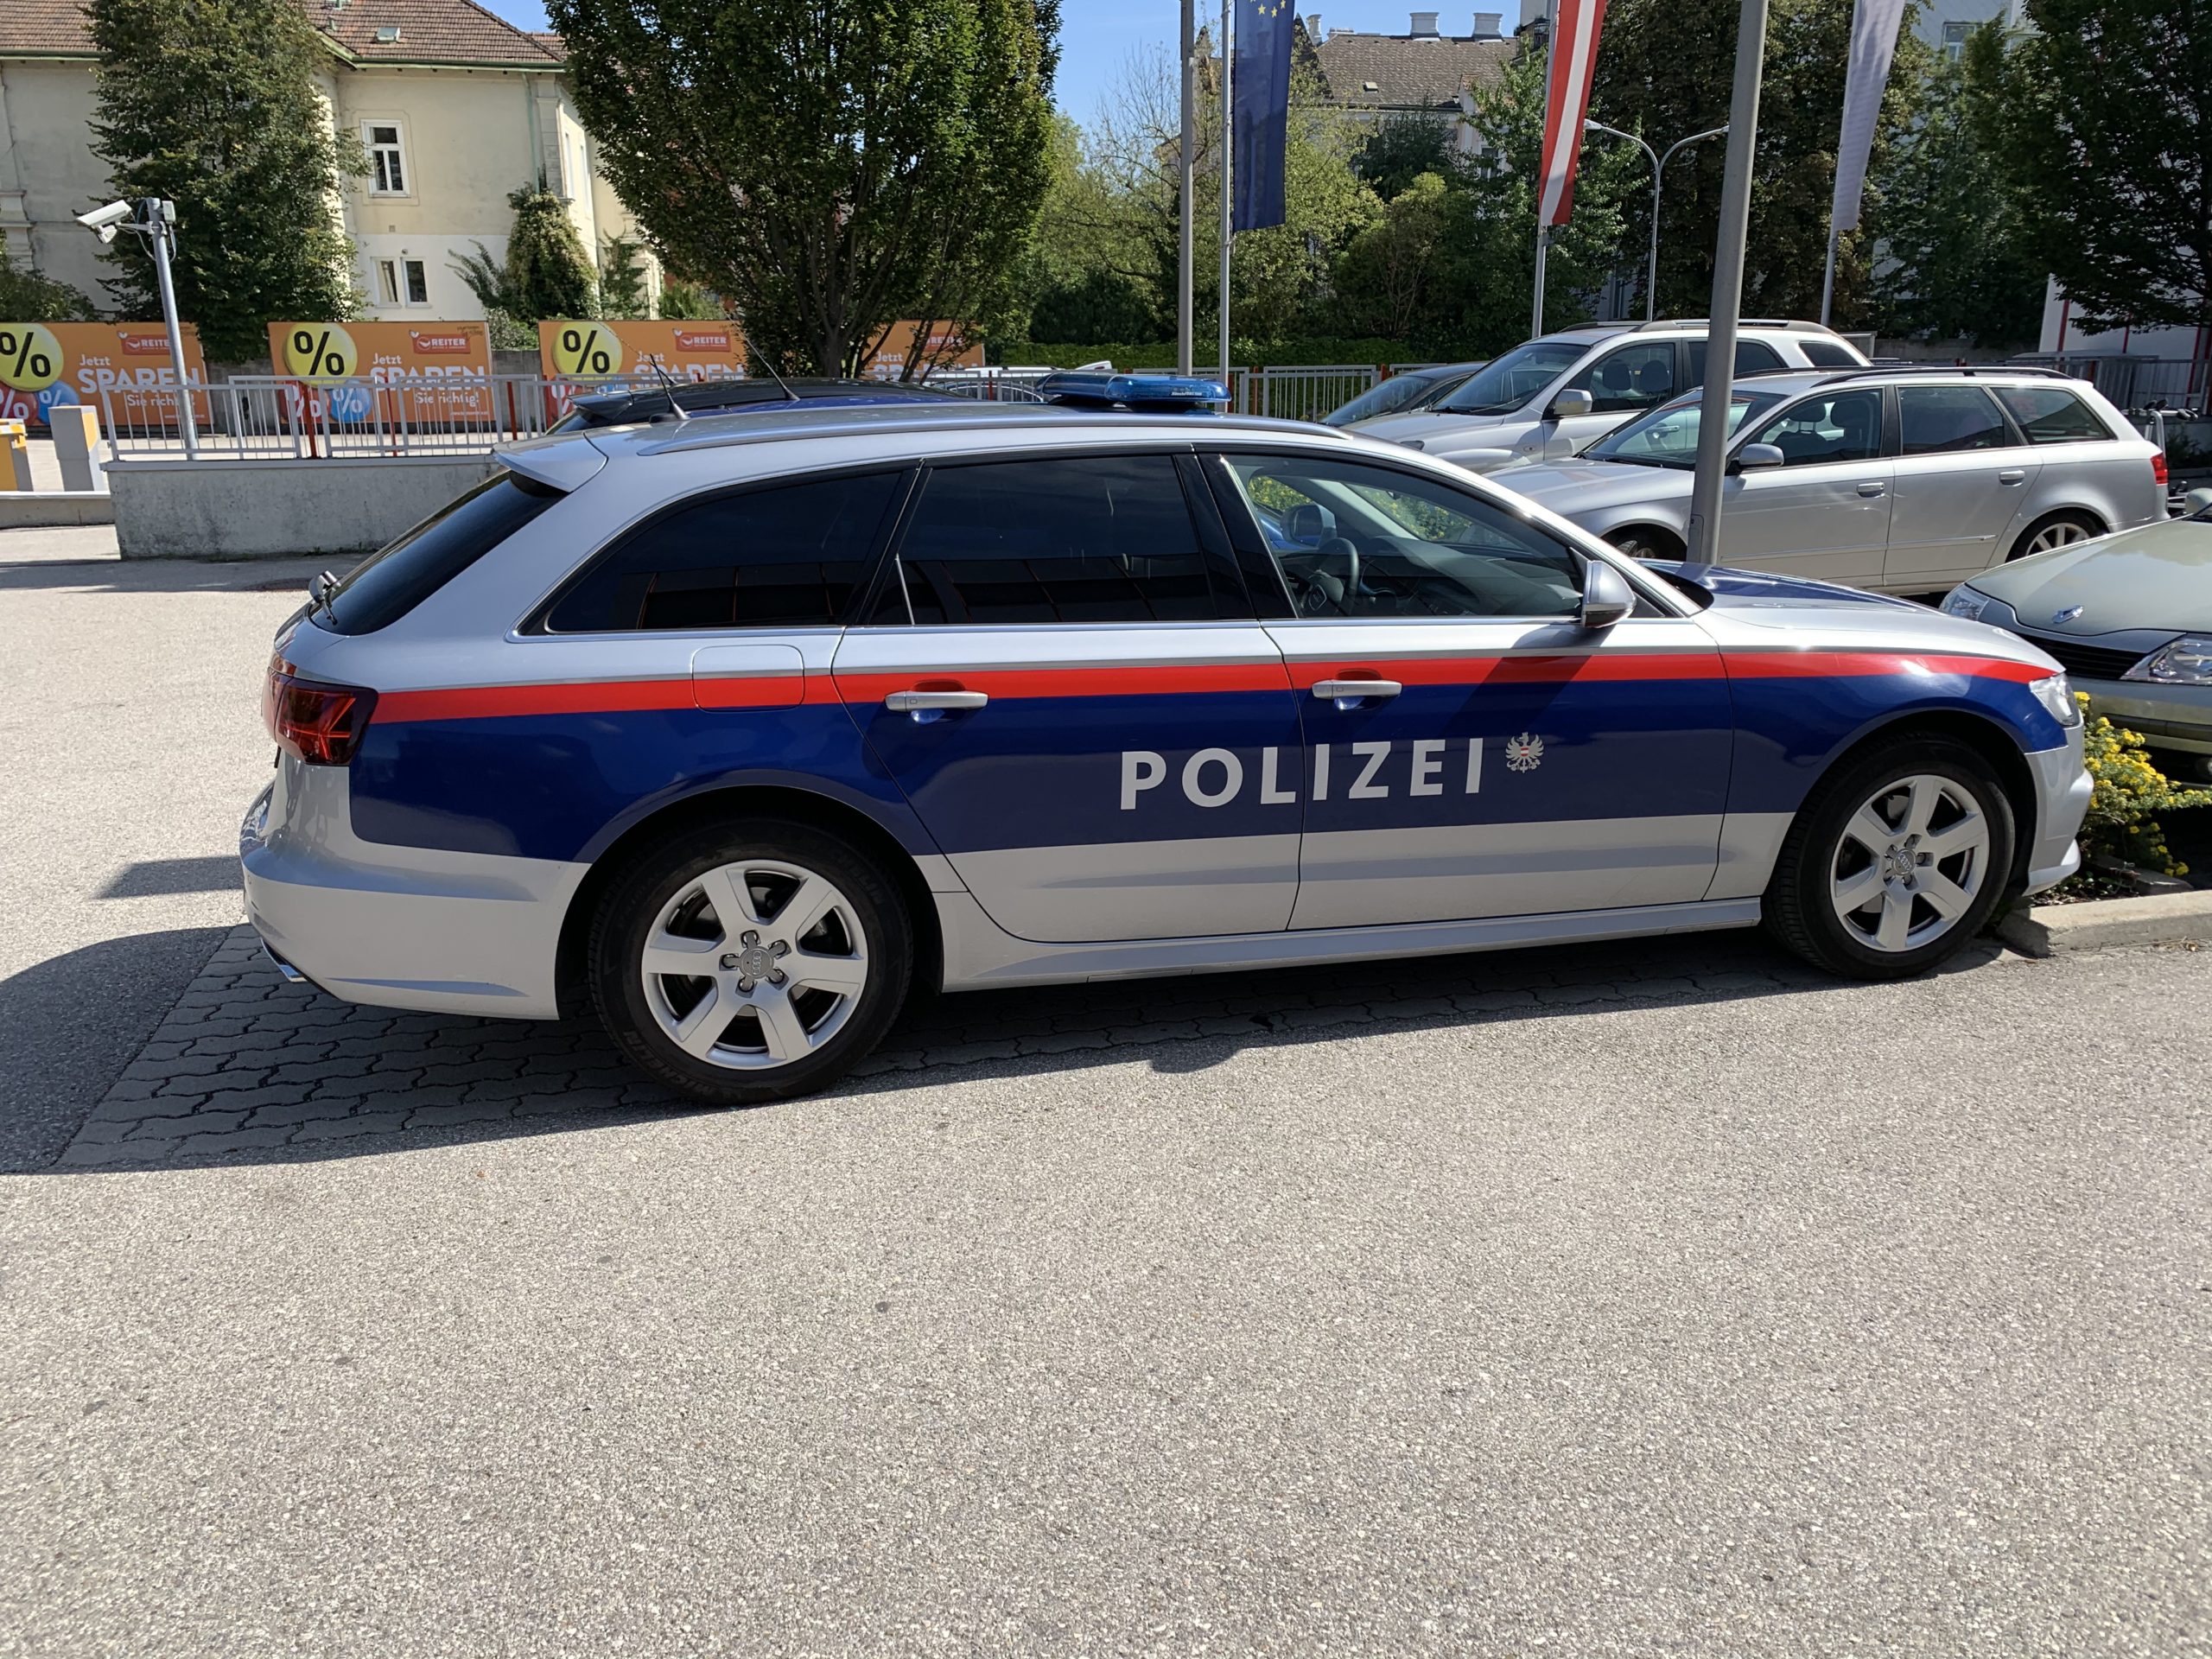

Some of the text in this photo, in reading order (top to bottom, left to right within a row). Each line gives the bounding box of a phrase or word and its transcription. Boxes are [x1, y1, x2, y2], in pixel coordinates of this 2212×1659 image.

[141, 338, 171, 347] REITE
[431, 338, 467, 346] REITER
[694, 335, 727, 345] REITER
[79, 353, 111, 366] Jetzt
[372, 353, 403, 365] Jetzt
[875, 350, 904, 362] Jetzt
[127, 394, 147, 406] Sie
[416, 391, 435, 404] Sie
[1120, 737, 1484, 810] POLIZEI
